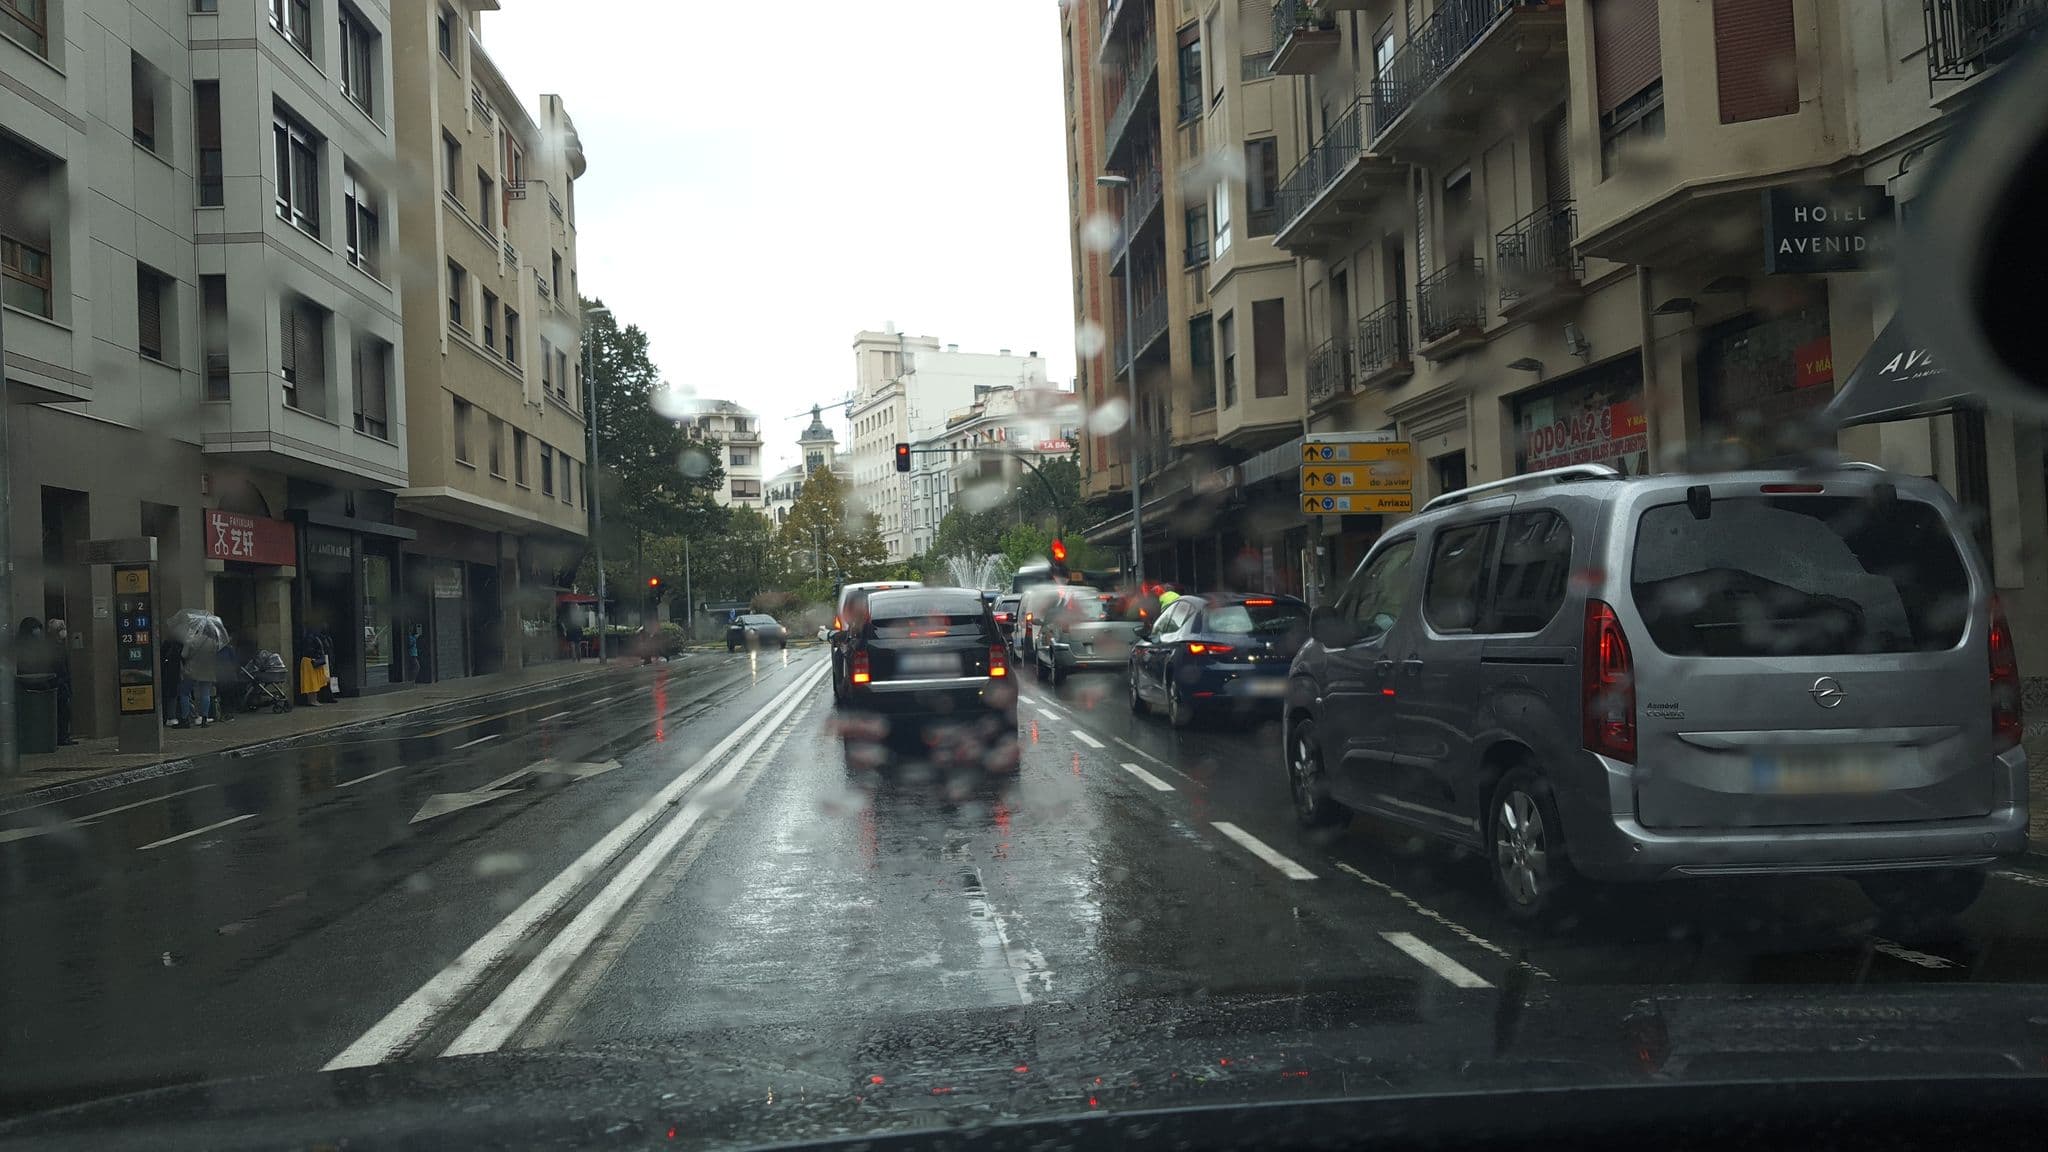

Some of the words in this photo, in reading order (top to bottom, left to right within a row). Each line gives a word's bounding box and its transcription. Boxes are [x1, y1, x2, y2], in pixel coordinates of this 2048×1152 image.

[1794, 205, 1866, 223] HOTEL
[1805, 361, 1814, 376] Y
[1815, 355, 1833, 374] MÁ
[1527, 420, 1567, 457] TODO
[1570, 415, 1582, 445] A
[1584, 411, 1597, 442] 2
[1384, 479, 1410, 487] Javier
[1377, 497, 1410, 507] Arriazu
[123, 603, 129, 611] 1
[138, 602, 144, 611] 2
[123, 618, 130, 627] 5
[137, 618, 146, 627] 11
[122, 634, 133, 643] 23
[137, 633, 147, 642] N1
[130, 650, 142, 659] N3
